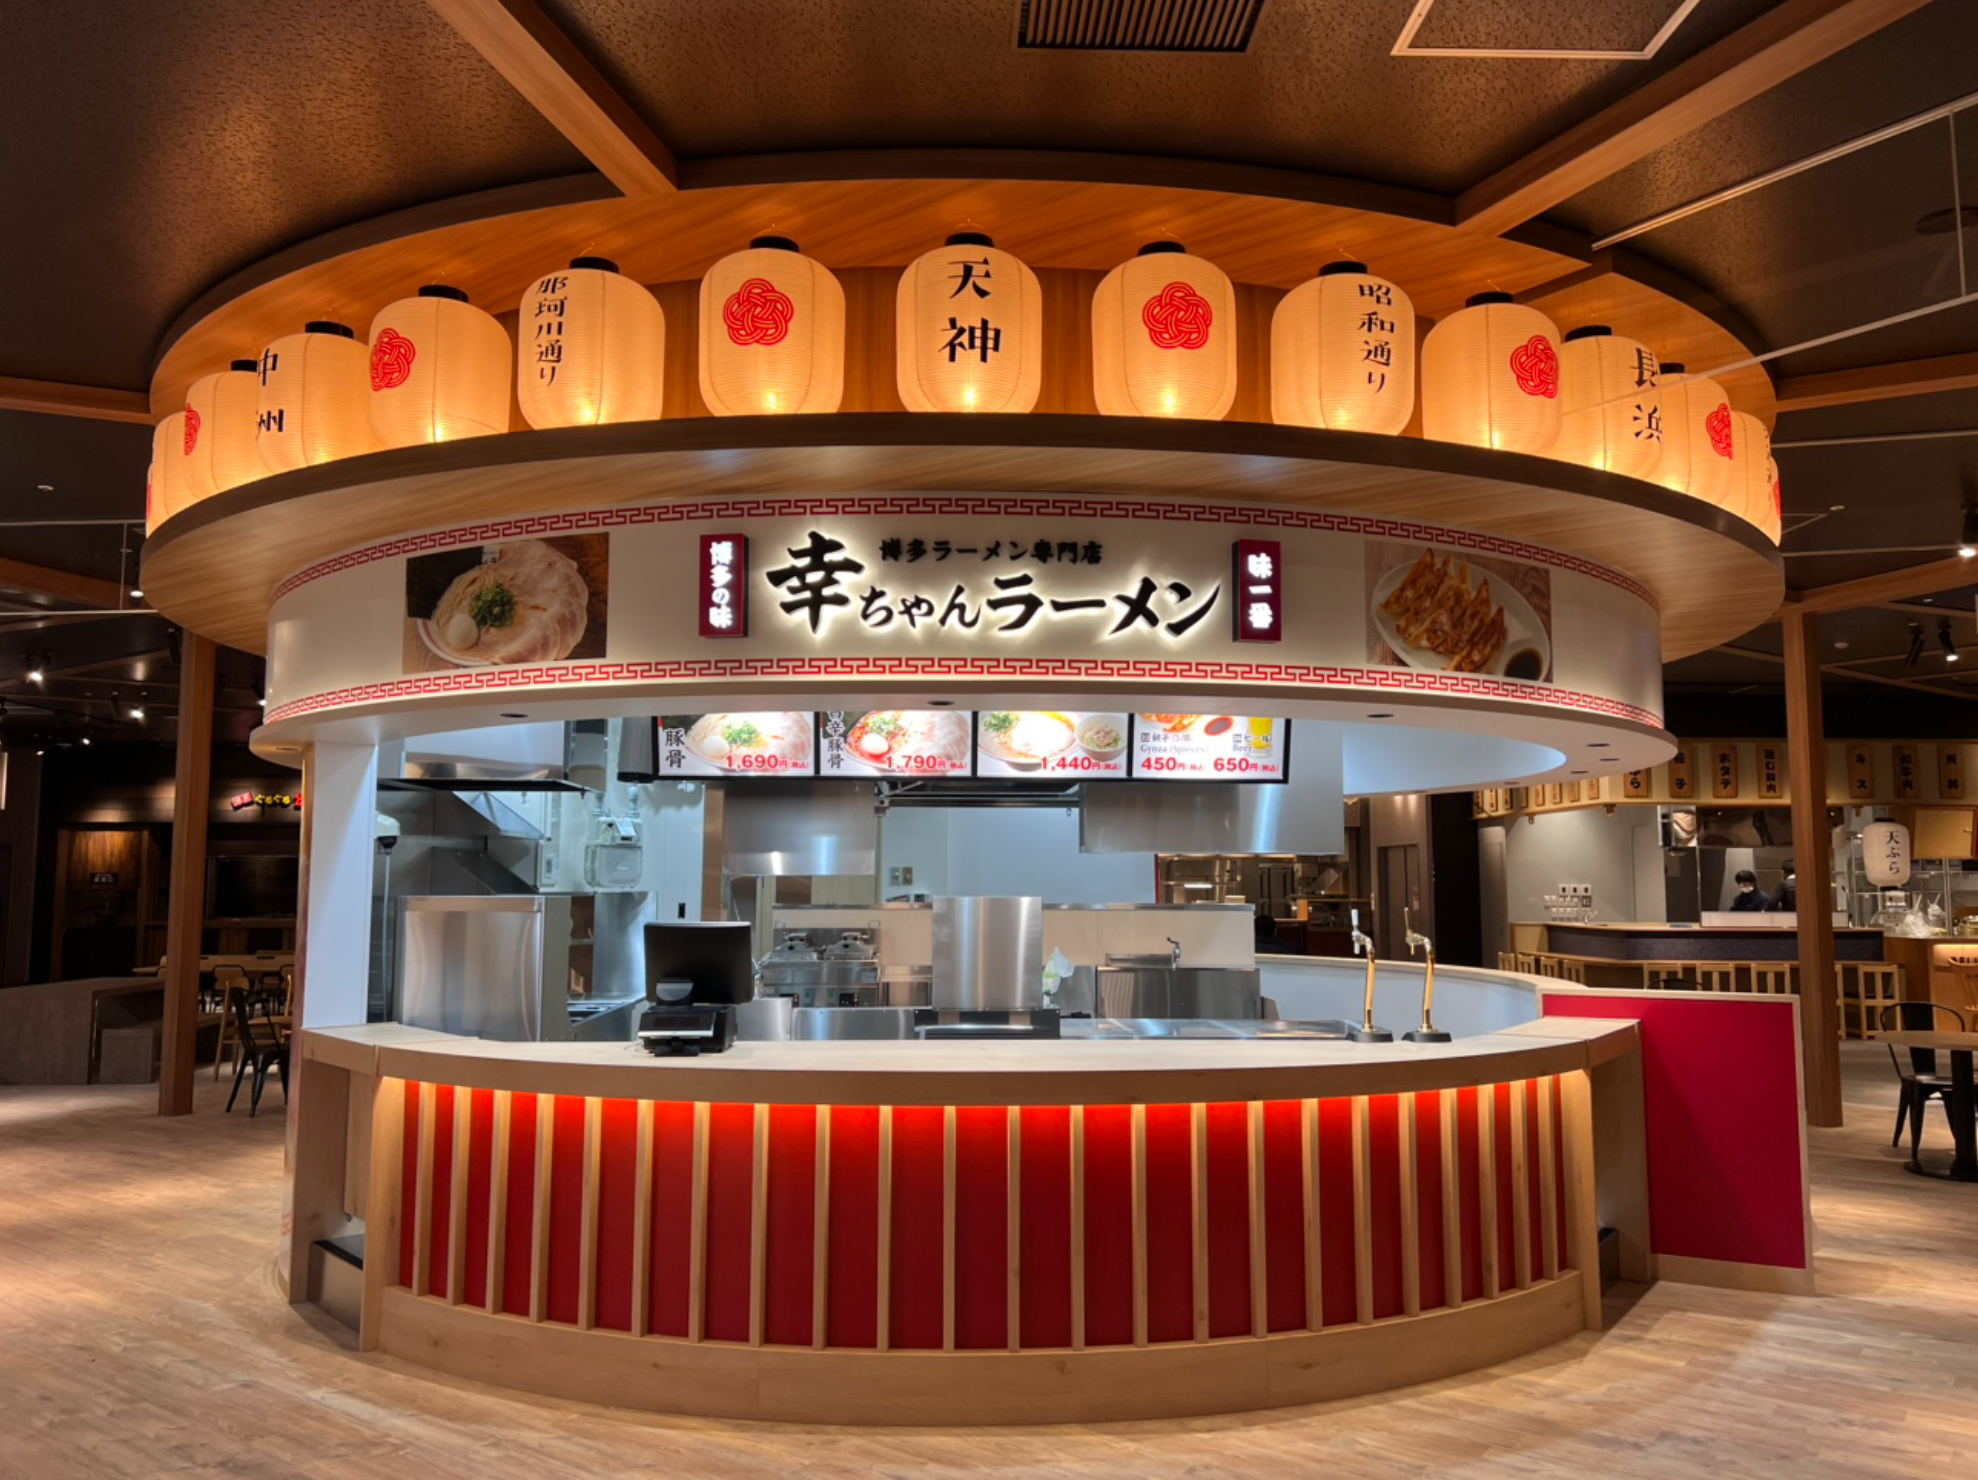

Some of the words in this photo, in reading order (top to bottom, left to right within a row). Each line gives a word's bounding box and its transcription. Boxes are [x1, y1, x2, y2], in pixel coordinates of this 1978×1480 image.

[535, 277, 568, 386] 那珂川通り
[938, 257, 1001, 363] 天神
[1358, 283, 1394, 394] 昭和通り
[1630, 347, 1662, 443] 長浜
[709, 541, 733, 629] 博多の味
[766, 531, 1221, 637] 幸ちゃんラーメン
[879, 538, 1102, 565] 博多ラーメン専門店
[1247, 552, 1273, 629] 味一番
[665, 729, 686, 768] 豚骨
[1718, 752, 1731, 790] ホタテ
[1855, 753, 1868, 790] キス
[1885, 830, 1901, 874] 天ぷら
